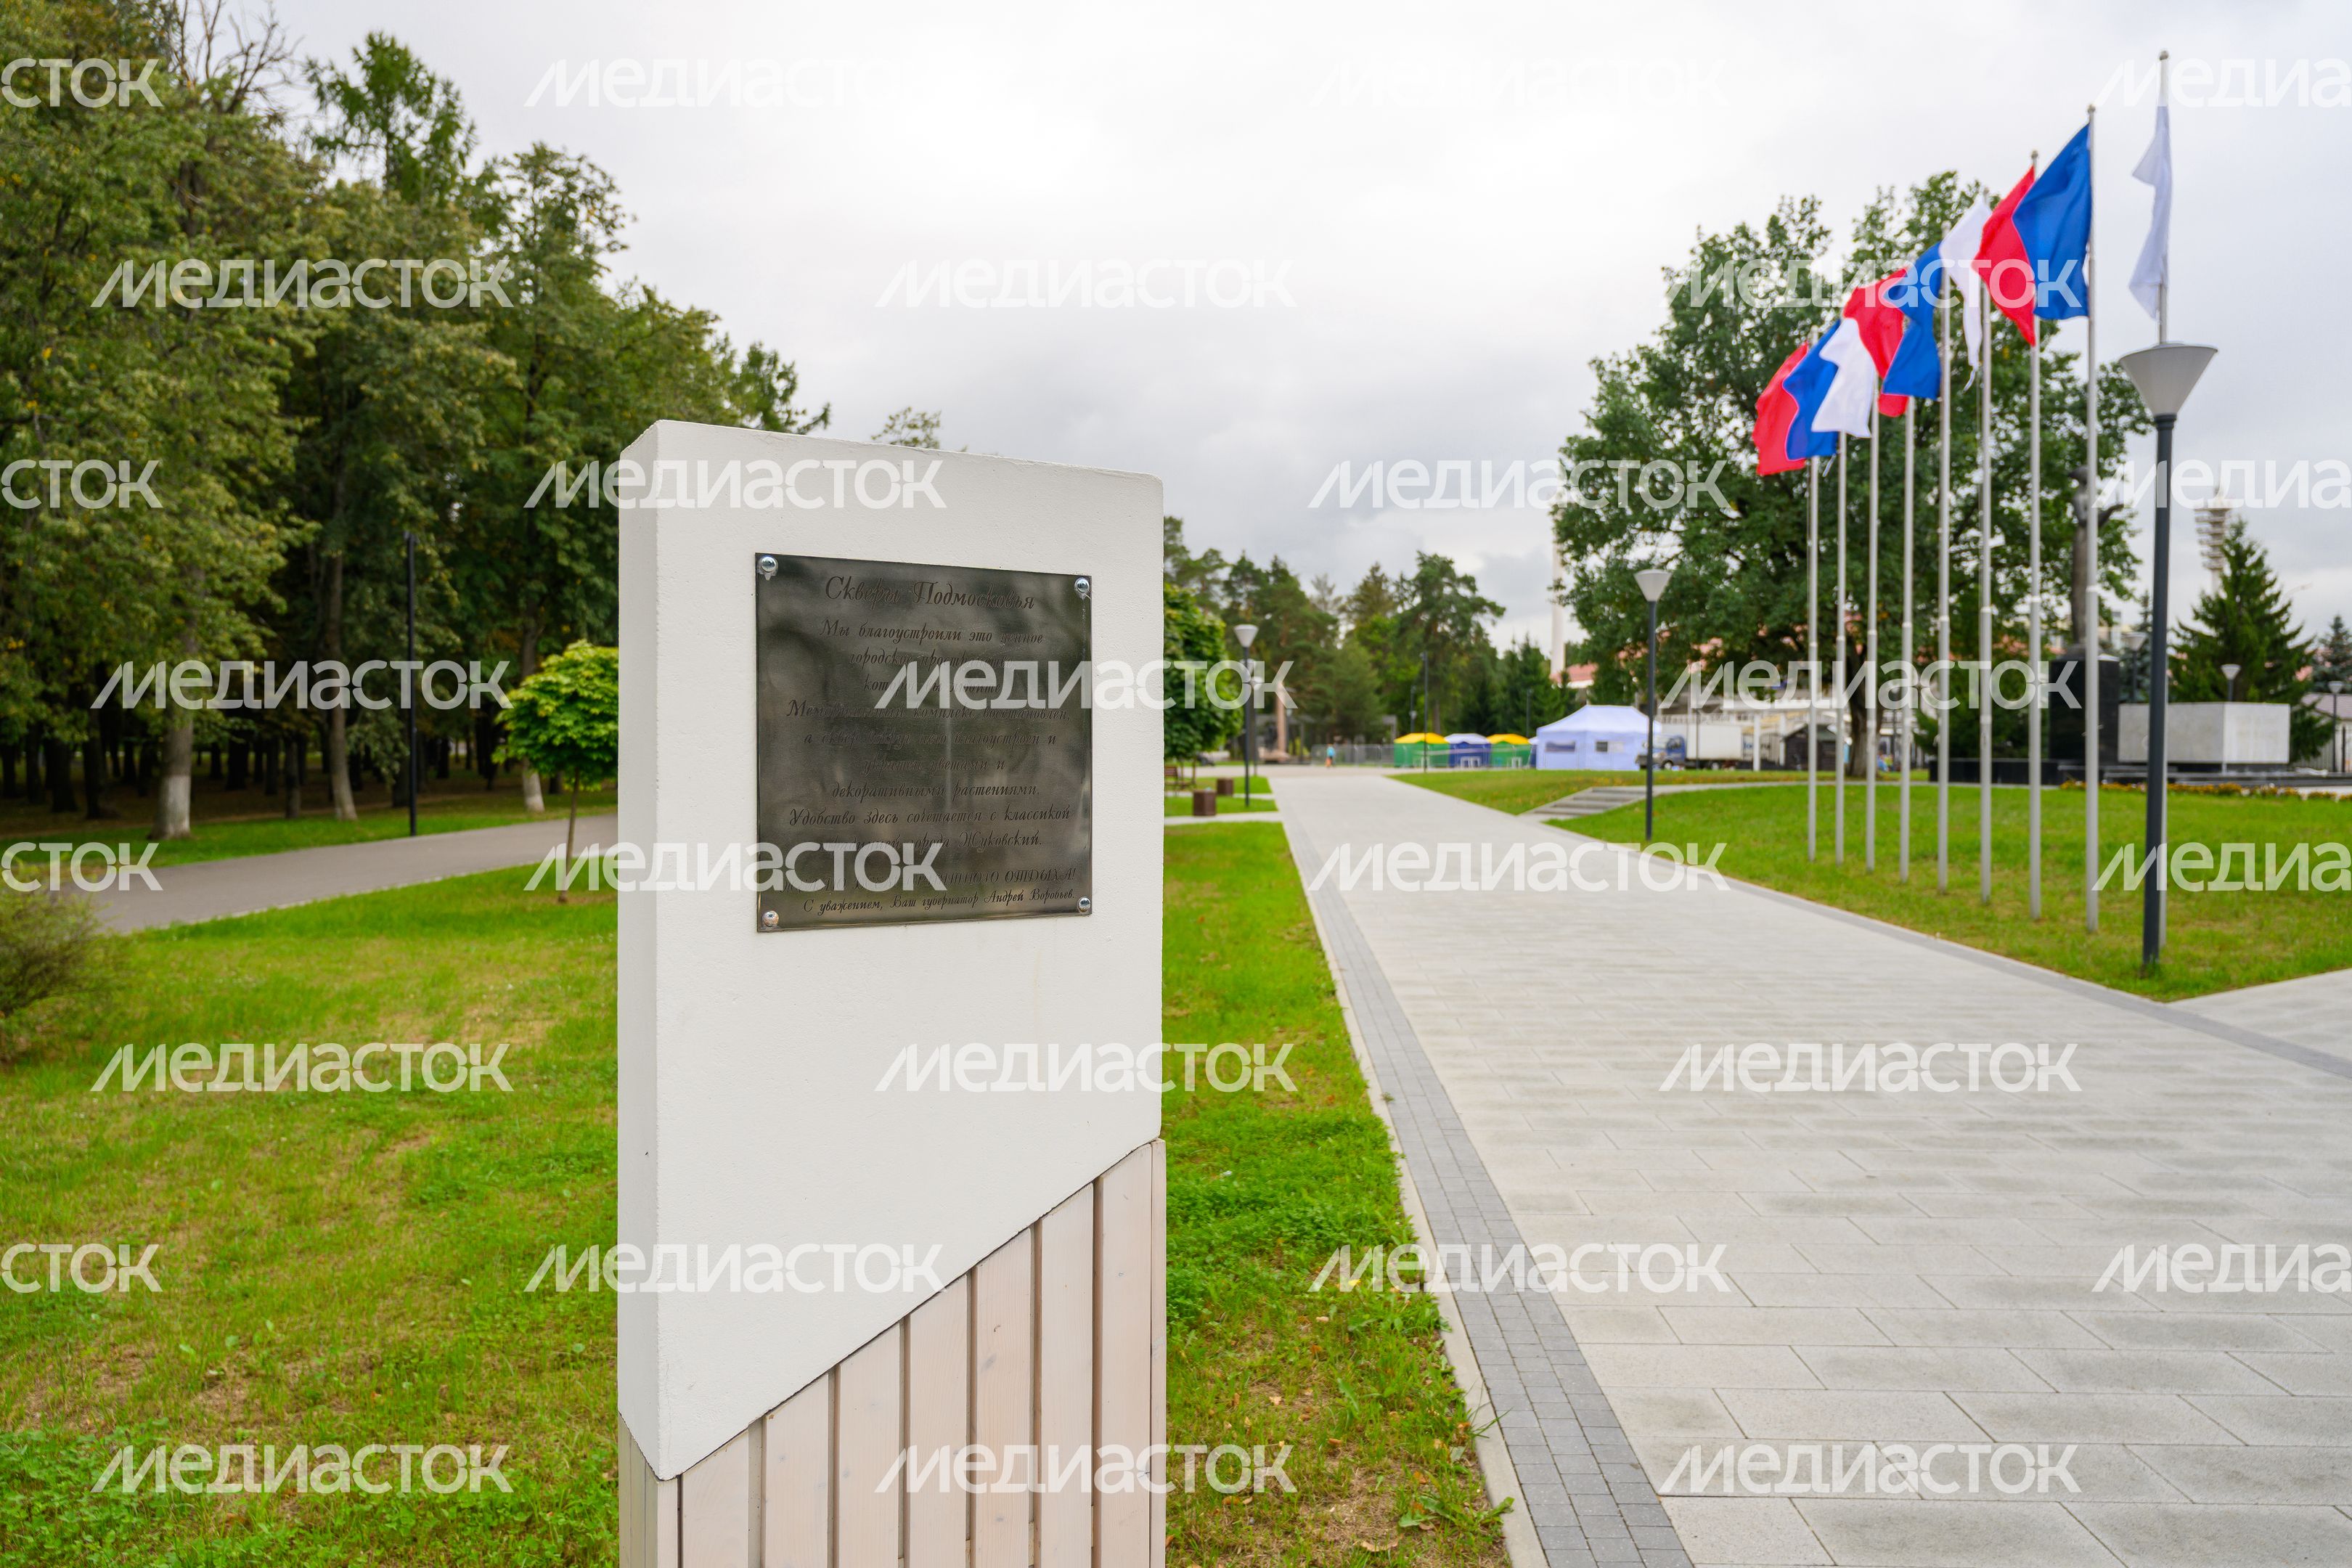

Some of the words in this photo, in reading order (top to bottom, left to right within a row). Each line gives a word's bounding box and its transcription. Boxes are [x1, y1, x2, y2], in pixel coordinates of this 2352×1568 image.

[825, 576, 901, 610] Скверы
[912, 581, 1034, 610] Подмосковья
[820, 619, 850, 636] Мы
[859, 622, 962, 645] благоустроили
[969, 631, 993, 642] это
[913, 704, 975, 719] комплекс
[983, 706, 1070, 721] восстановлен,
[804, 734, 814, 744] а
[955, 727, 1040, 750] благоустроен
[1048, 734, 1058, 745] и
[996, 759, 1005, 770] и
[832, 780, 945, 803] декоративными
[952, 780, 1040, 801] растениями.
[790, 807, 855, 825] Удобство
[864, 807, 899, 825] здесь
[907, 808, 982, 824] сочетается
[990, 811, 997, 821] с
[1004, 804, 1070, 821] классикой
[959, 830, 1042, 853] Жуковский.
[1005, 868, 1077, 883] ОТДЫХА!
[804, 899, 814, 912] С
[817, 899, 883, 915] уважением,
[890, 894, 916, 908] Ваш
[922, 891, 979, 911] губернатор
[984, 889, 1024, 906] Андрей
[1029, 889, 1074, 904] Воробьев.
